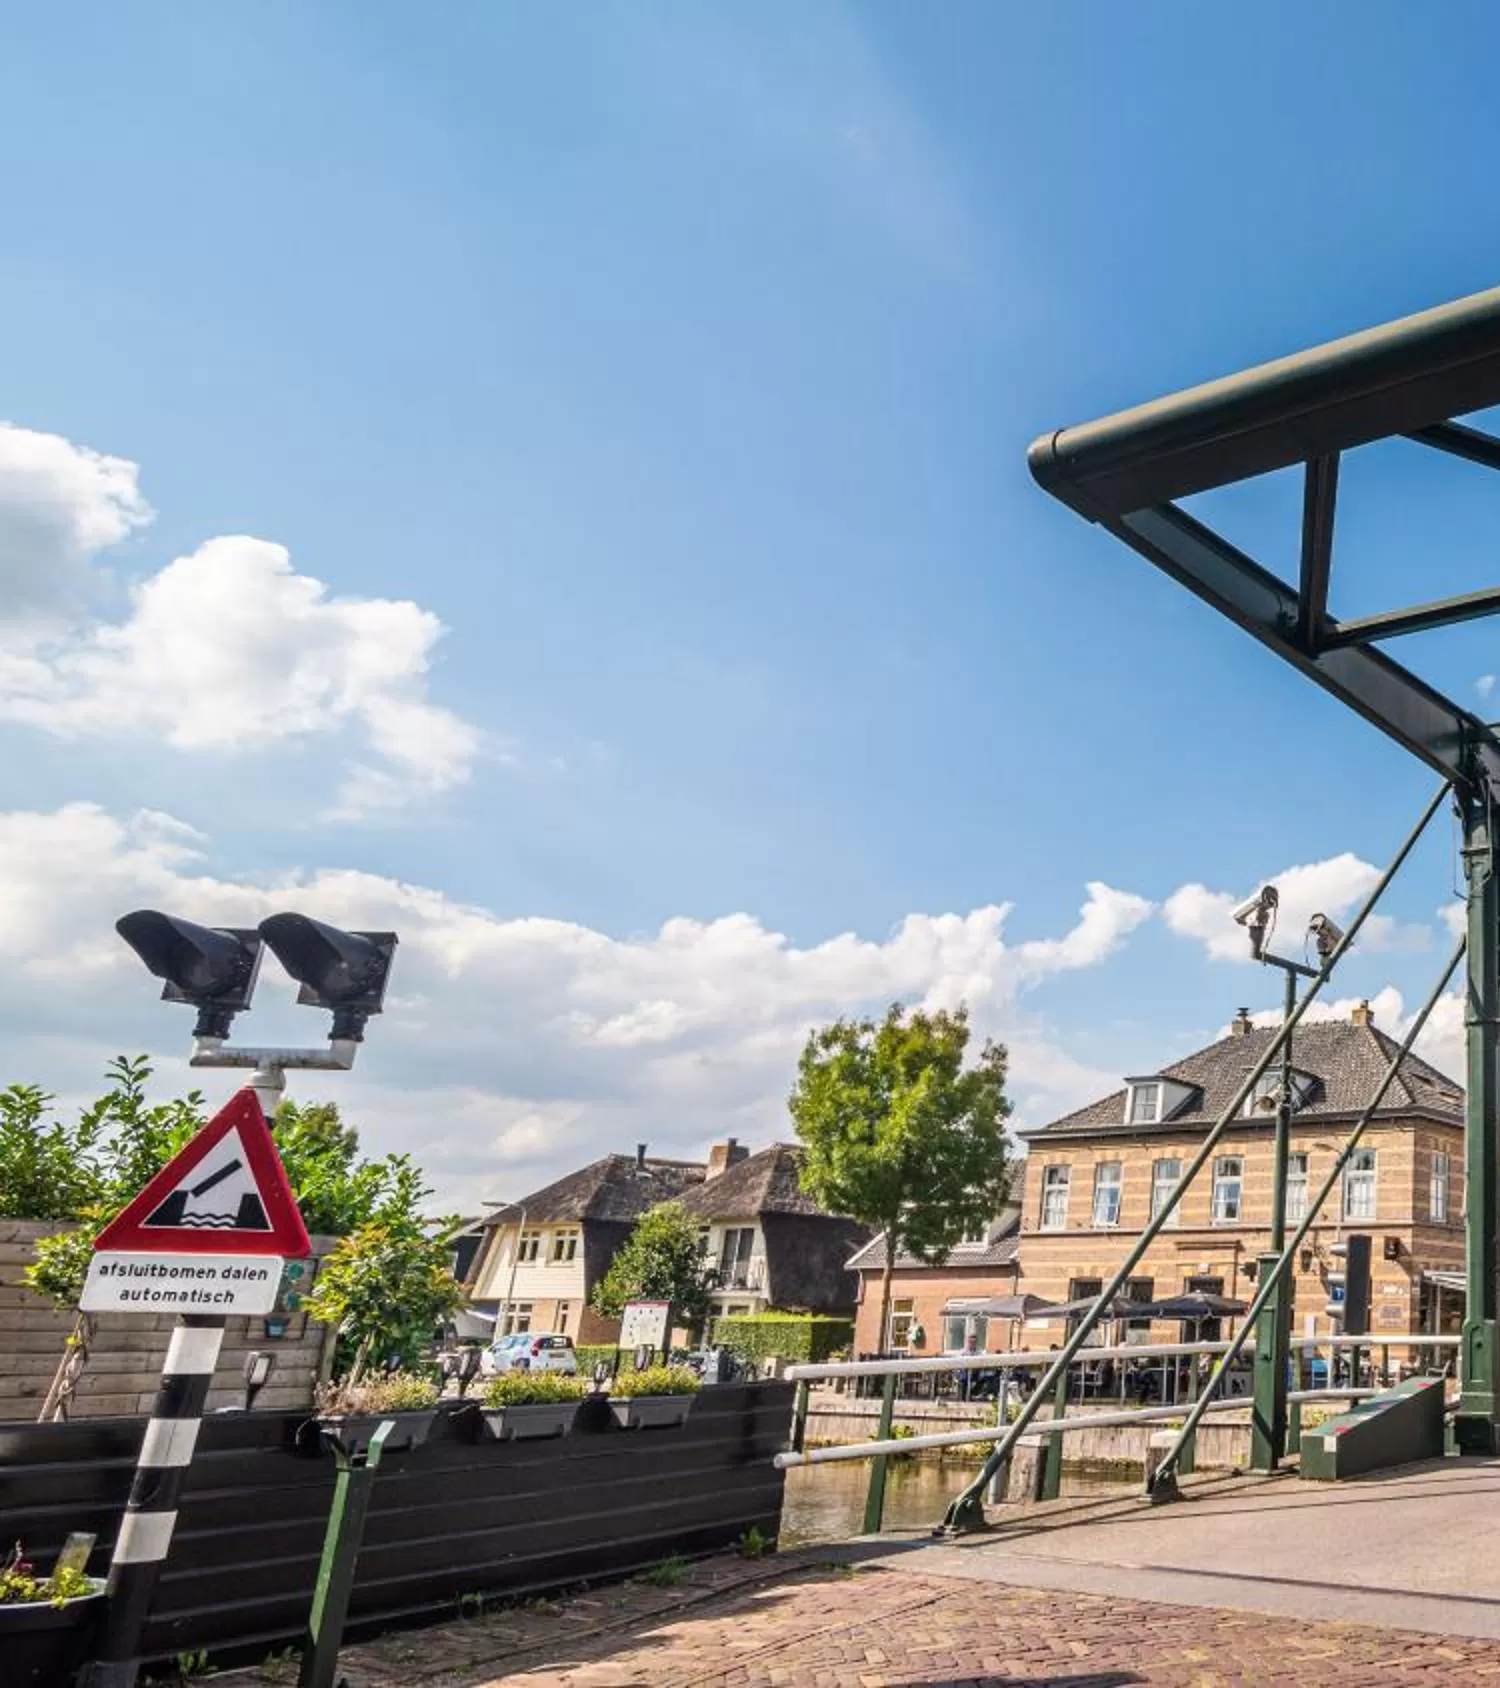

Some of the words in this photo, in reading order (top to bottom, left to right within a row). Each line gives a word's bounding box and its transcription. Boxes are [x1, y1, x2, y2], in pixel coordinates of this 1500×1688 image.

[100, 1263, 217, 1279] afsluitbomen
[221, 1266, 268, 1280] dalen
[120, 1287, 236, 1304] automatisch
